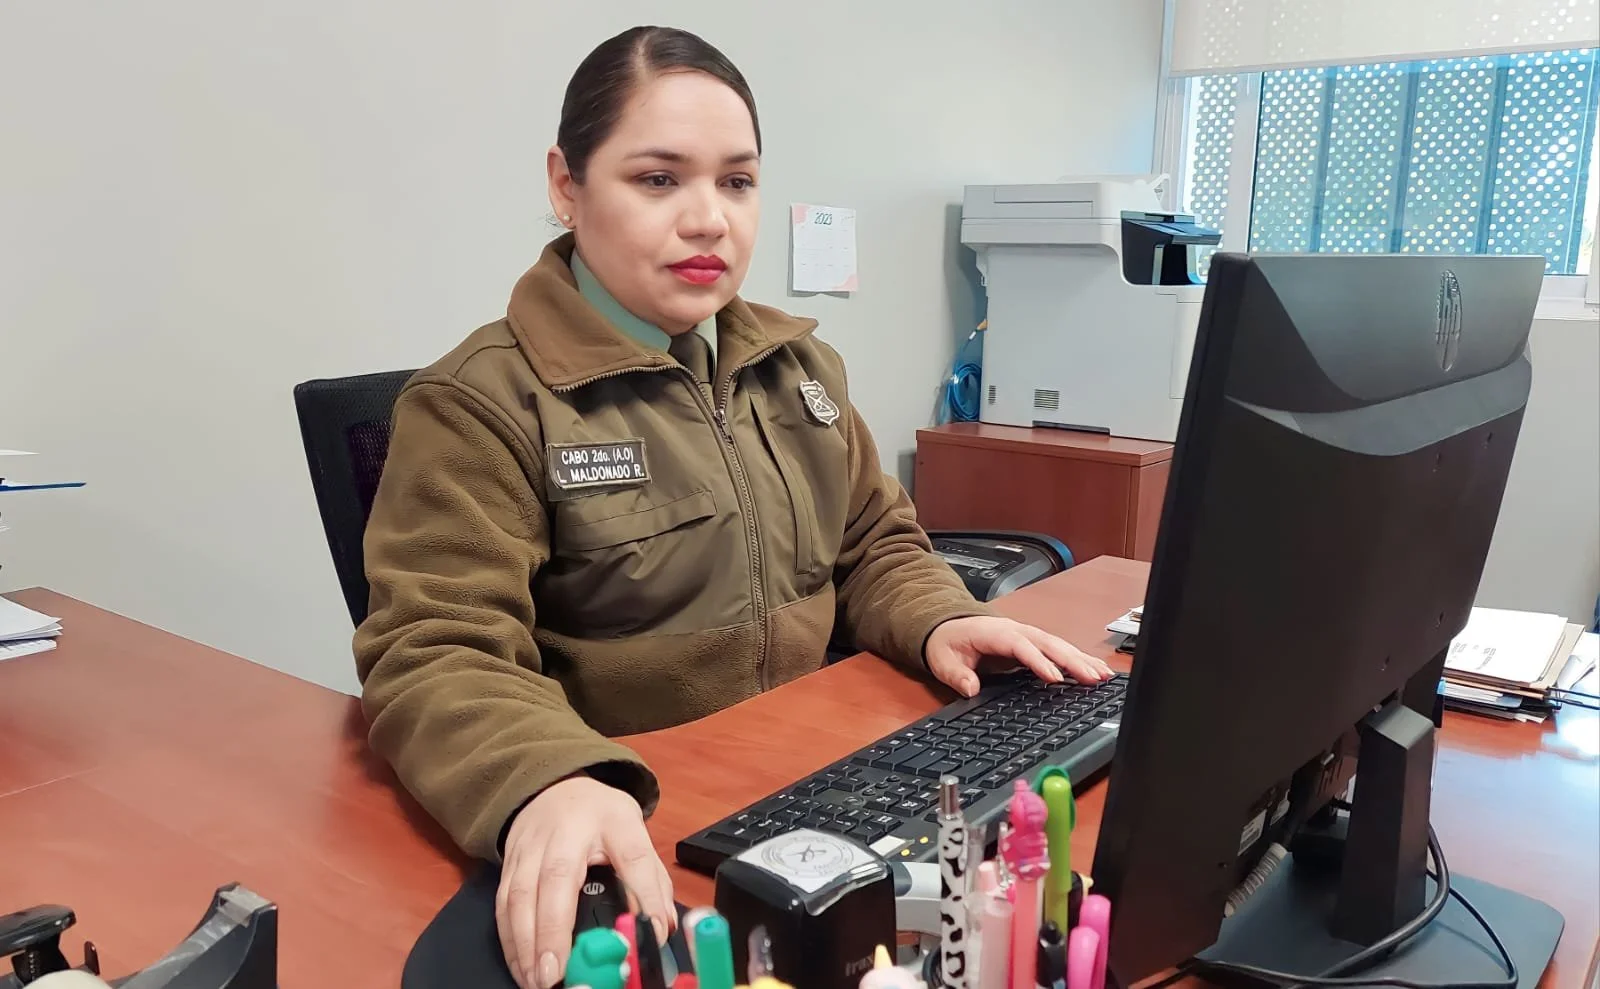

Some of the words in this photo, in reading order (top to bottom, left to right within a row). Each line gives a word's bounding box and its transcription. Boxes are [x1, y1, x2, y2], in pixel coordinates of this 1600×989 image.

[561, 450, 589, 465] CABO
[591, 449, 611, 463] 2do.
[612, 446, 634, 464] (A.O)
[570, 464, 630, 482] MALDONADO
[633, 463, 645, 478] R.
[582, 881, 606, 896] hp
